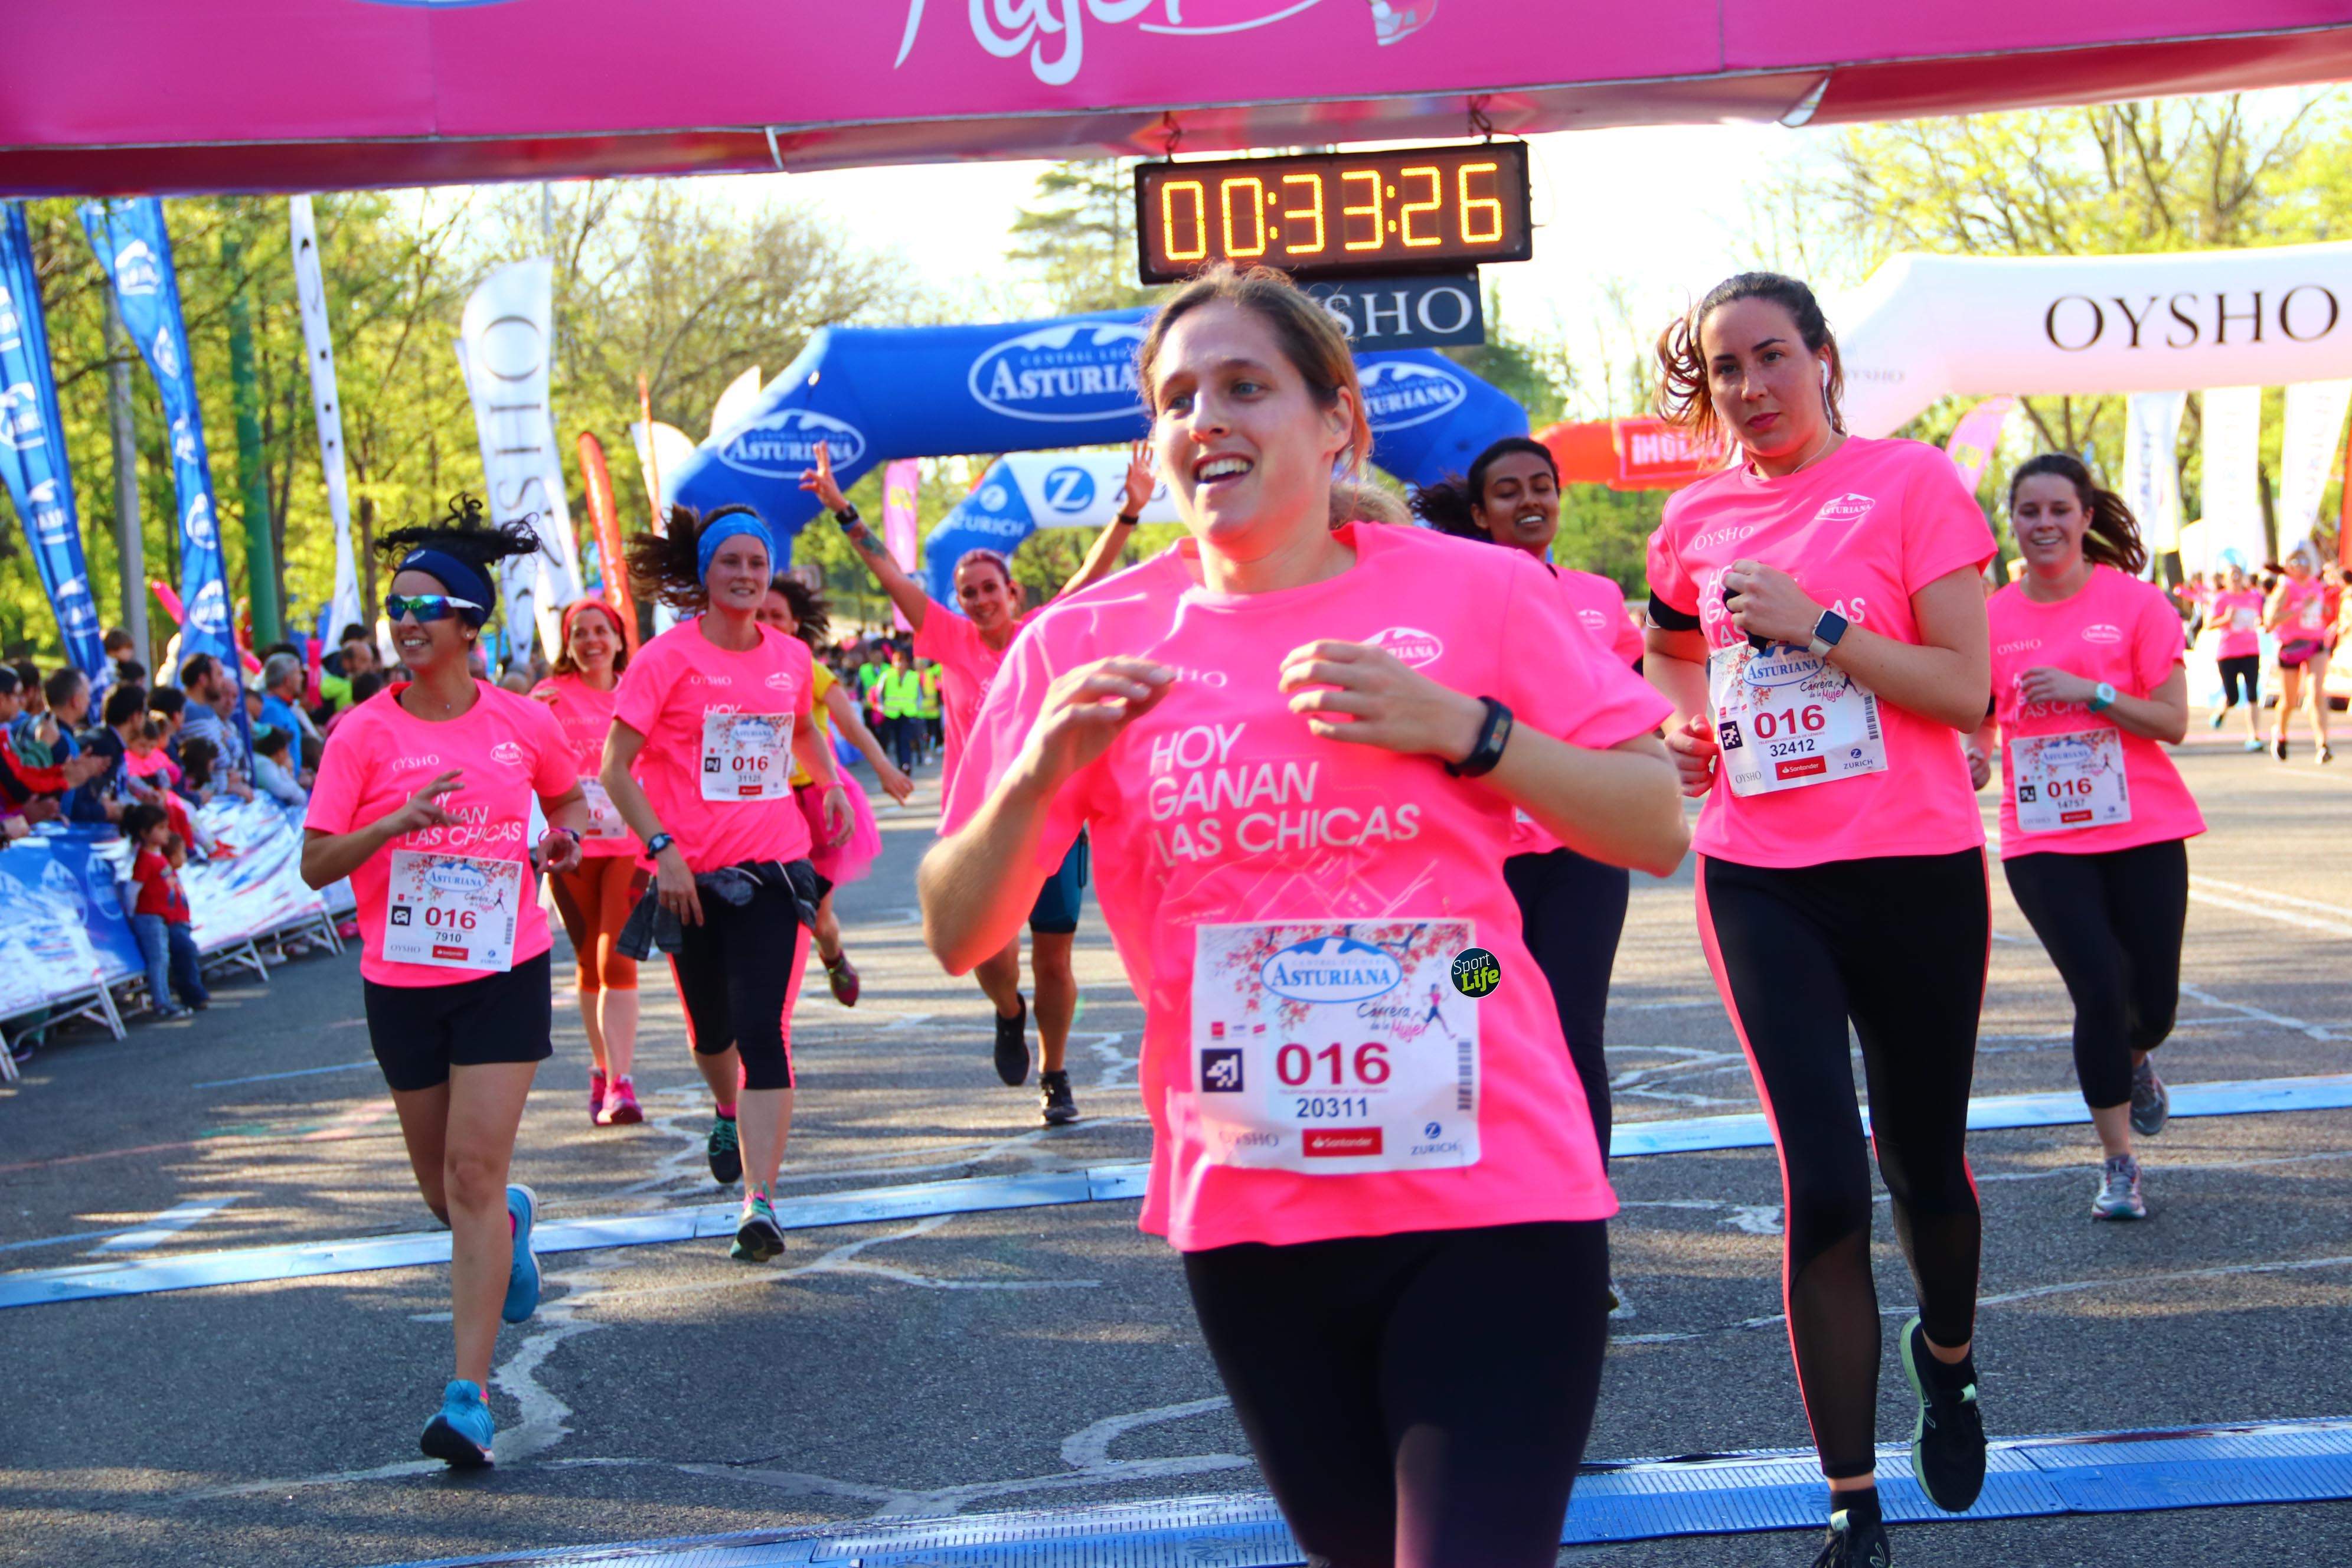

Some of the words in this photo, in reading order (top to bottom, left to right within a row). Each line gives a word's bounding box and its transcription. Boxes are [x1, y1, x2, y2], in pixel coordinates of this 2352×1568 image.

[1161, 162, 1502, 261] 00:33:26
[1315, 287, 1473, 339] SHO
[2045, 284, 2340, 351] OYSHO
[988, 357, 1138, 401] ASTURIA
[727, 436, 854, 460] ASTURINA
[1694, 525, 1754, 551] OYSHO
[1997, 638, 2042, 656] OYSHO
[1748, 659, 1820, 681] ASTURIANA
[1800, 679, 1833, 692] Carrera
[1821, 687, 1845, 703] Mujer
[1754, 704, 1825, 739] 016
[1148, 722, 1247, 776] HOY
[1770, 739, 1815, 757] 32412
[732, 756, 769, 772] 016
[1735, 770, 1762, 784] OYSHO
[1789, 762, 1819, 773] Santander
[1843, 759, 1873, 770] ZURICH
[1148, 761, 1319, 821] GANAN
[2047, 777, 2092, 798] 016
[405, 827, 442, 847] LAS
[448, 821, 522, 846] CHICAS
[1146, 818, 1223, 868] LAS
[1235, 803, 1421, 853] CHICAS
[429, 871, 482, 886] ASTURIANA
[424, 906, 477, 930] 016
[390, 943, 421, 954] OYSHO
[435, 931, 462, 943] 7910
[1271, 962, 1391, 986] ASTURIANA
[1357, 1002, 1410, 1018] Carrera
[1389, 1017, 1430, 1043] Mujer
[1276, 1041, 1391, 1086] 016
[1296, 1097, 1367, 1118] 20311
[1324, 1137, 1373, 1148] Santander
[1410, 1142, 1458, 1155] ZURICH
